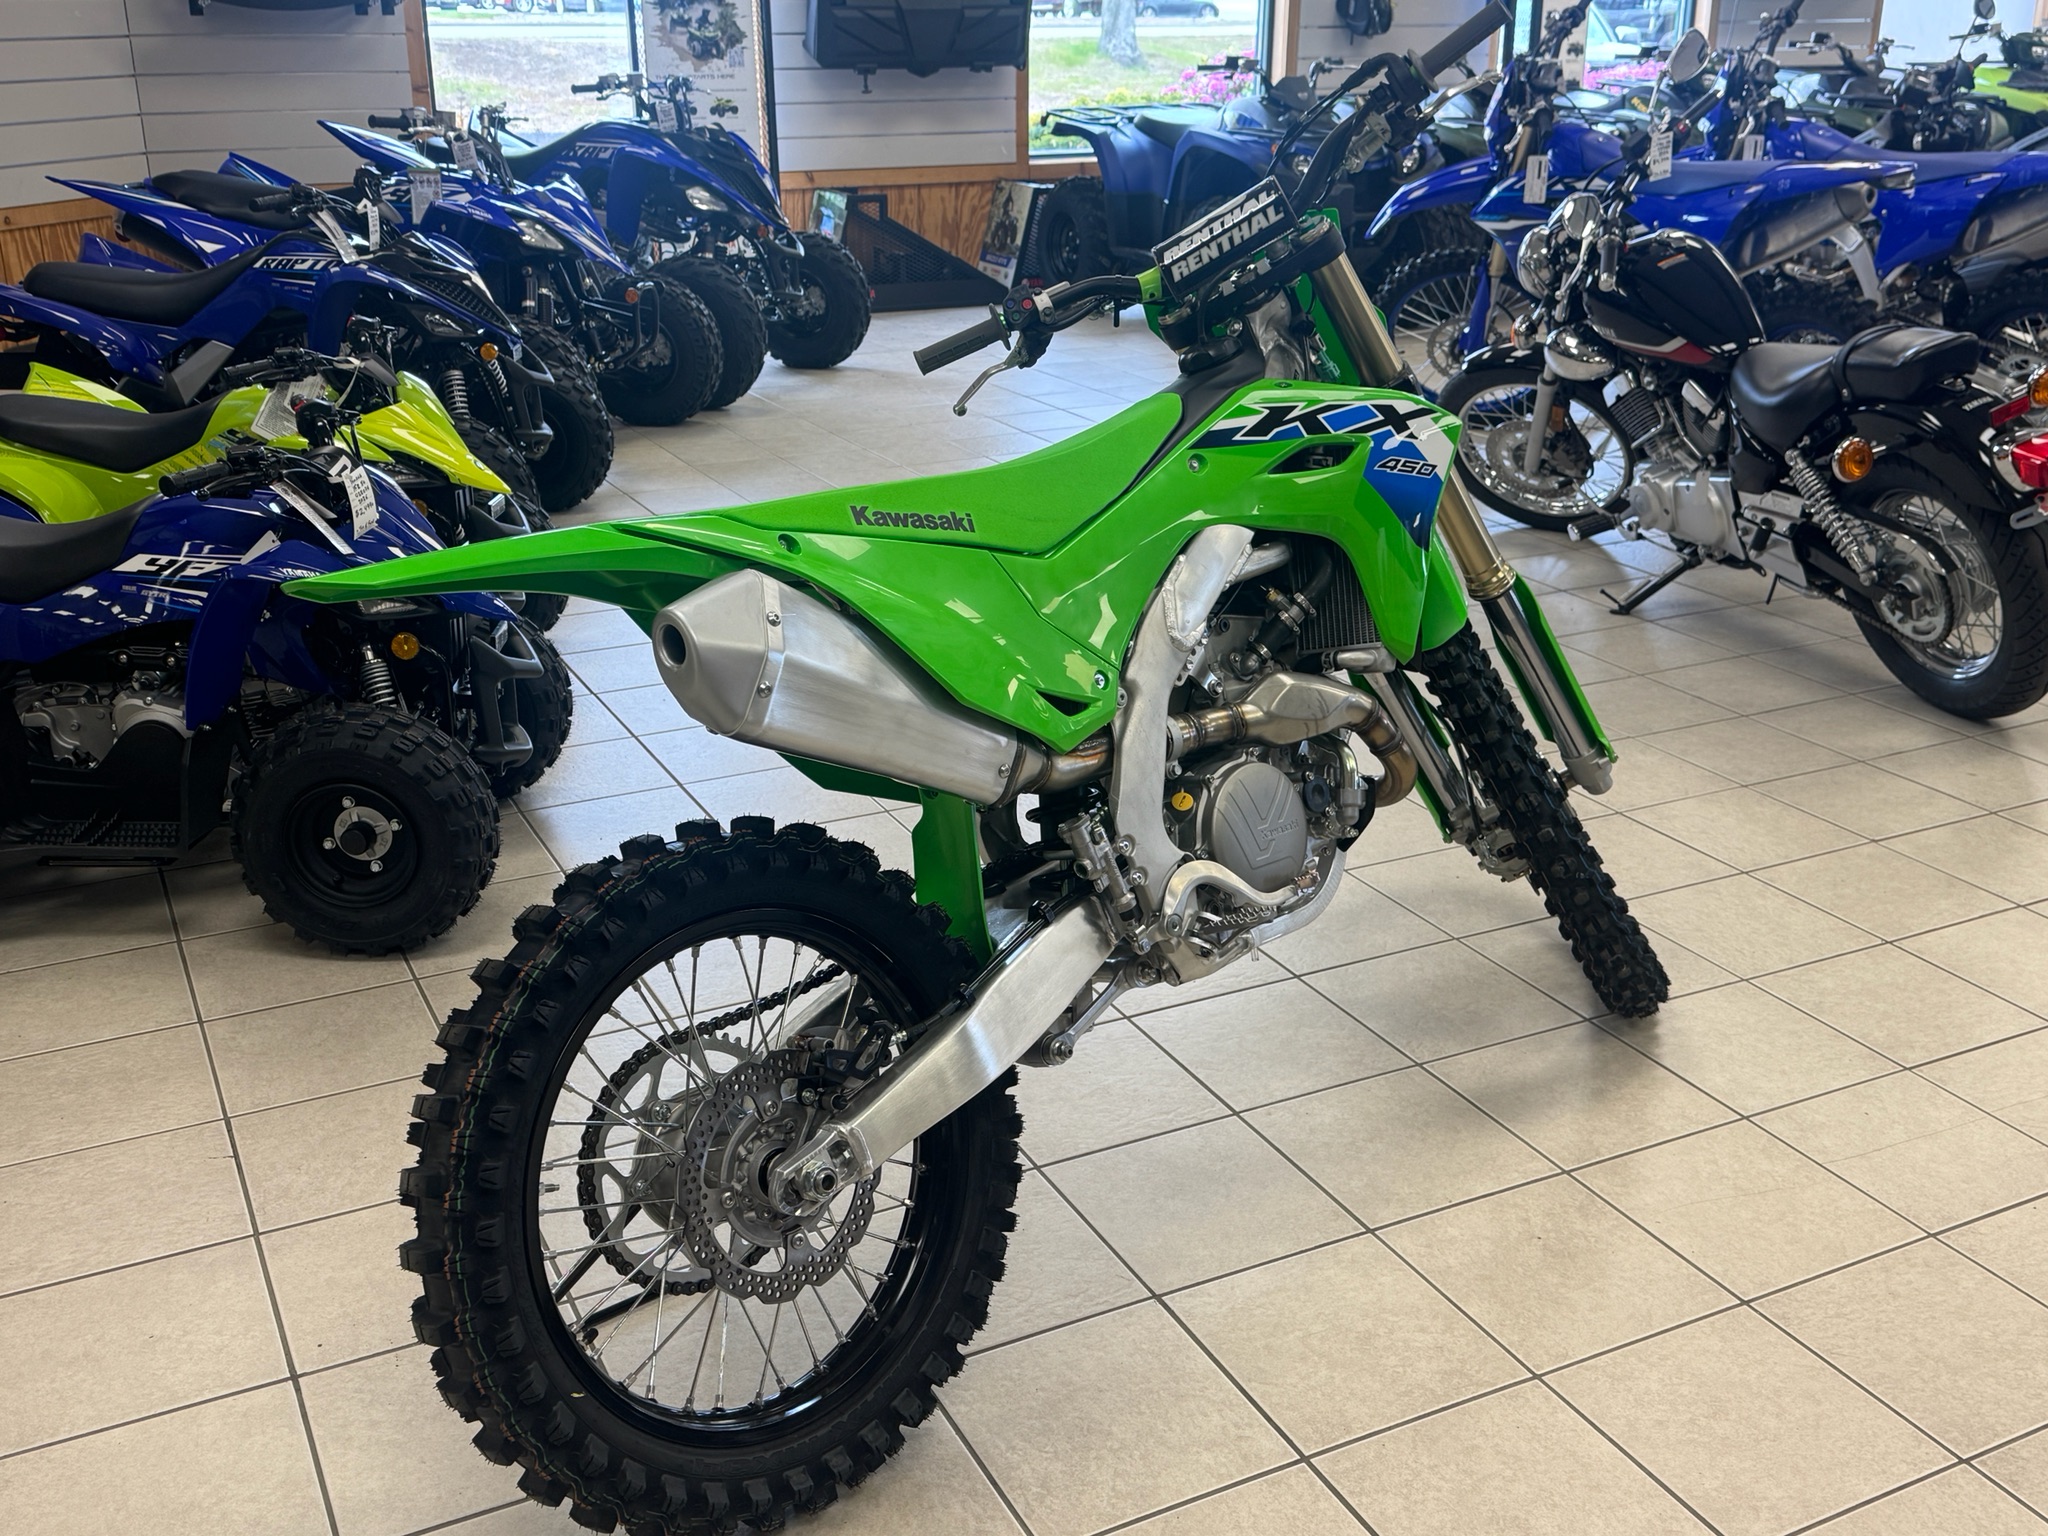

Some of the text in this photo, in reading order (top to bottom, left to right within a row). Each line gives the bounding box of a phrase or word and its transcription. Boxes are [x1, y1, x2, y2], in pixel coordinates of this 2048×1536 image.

[1162, 190, 1277, 265] RENTHAL
[1170, 204, 1286, 284] RENTHAL
[1231, 401, 1444, 441] KX
[1961, 396, 1994, 412] YAMAHA
[1374, 455, 1439, 478] 450
[849, 505, 976, 533] Kawasaki
